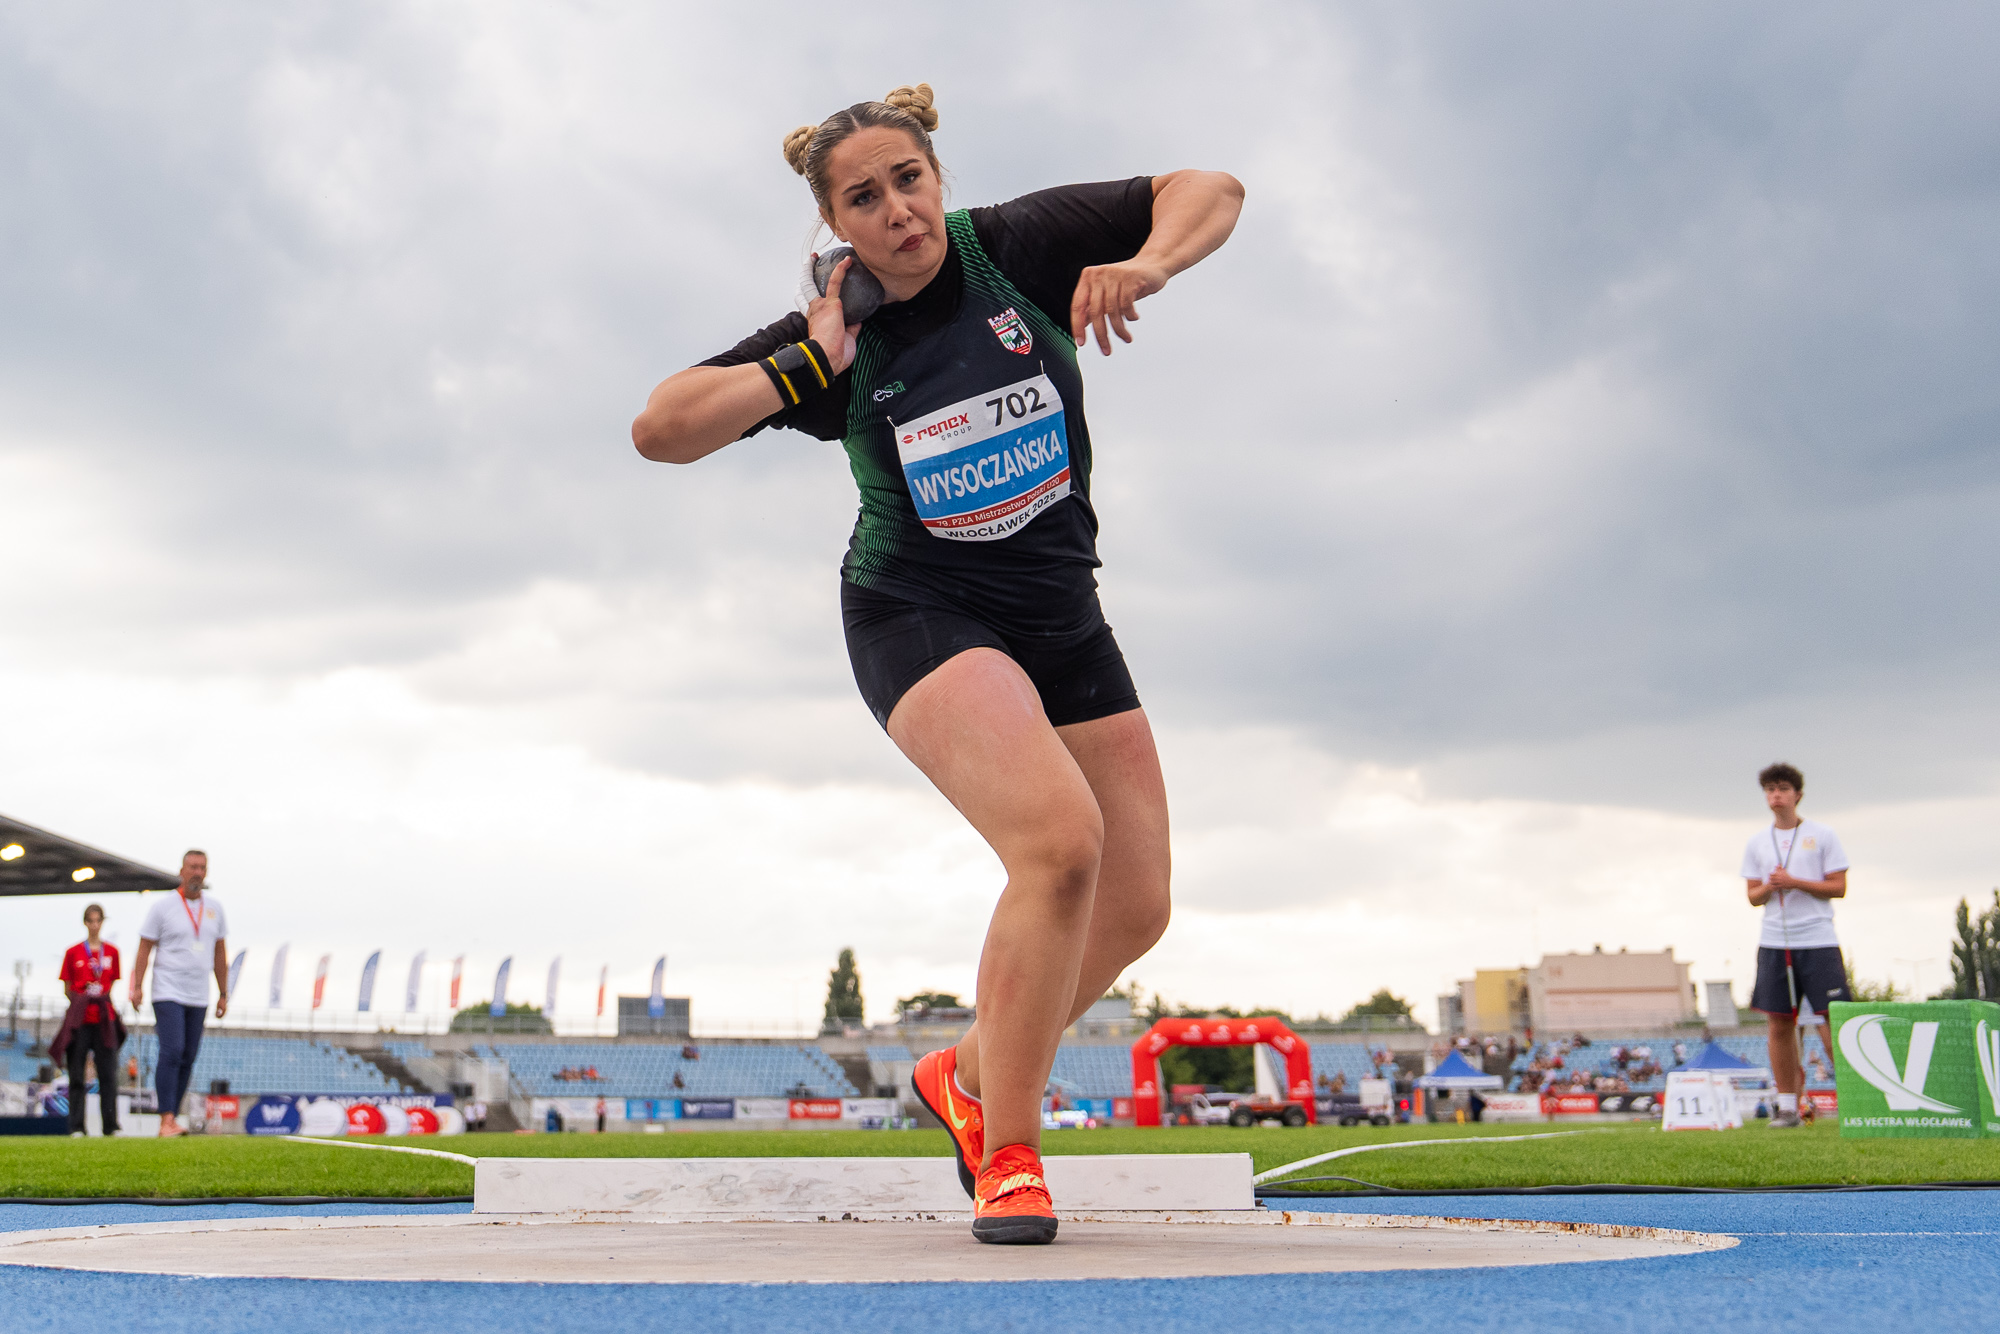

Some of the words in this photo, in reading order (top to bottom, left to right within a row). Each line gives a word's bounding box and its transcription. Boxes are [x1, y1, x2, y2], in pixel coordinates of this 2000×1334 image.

[986, 387, 1048, 427] 702
[941, 425, 972, 441] GROUP
[913, 429, 1063, 506] WYSOCZAŃSKA
[945, 508, 1031, 538] WŁOCŁAWEK
[1032, 491, 1056, 513] 2025
[952, 516, 974, 526] PZLA
[974, 498, 1027, 521] Mistrzostwa
[1027, 484, 1046, 502] Polski
[1047, 477, 1060, 489] U20
[1677, 1096, 1704, 1115] 11
[1844, 1117, 1863, 1127] LKS
[1864, 1117, 1904, 1127] VECTRA
[996, 1173, 1045, 1197] NIKE
